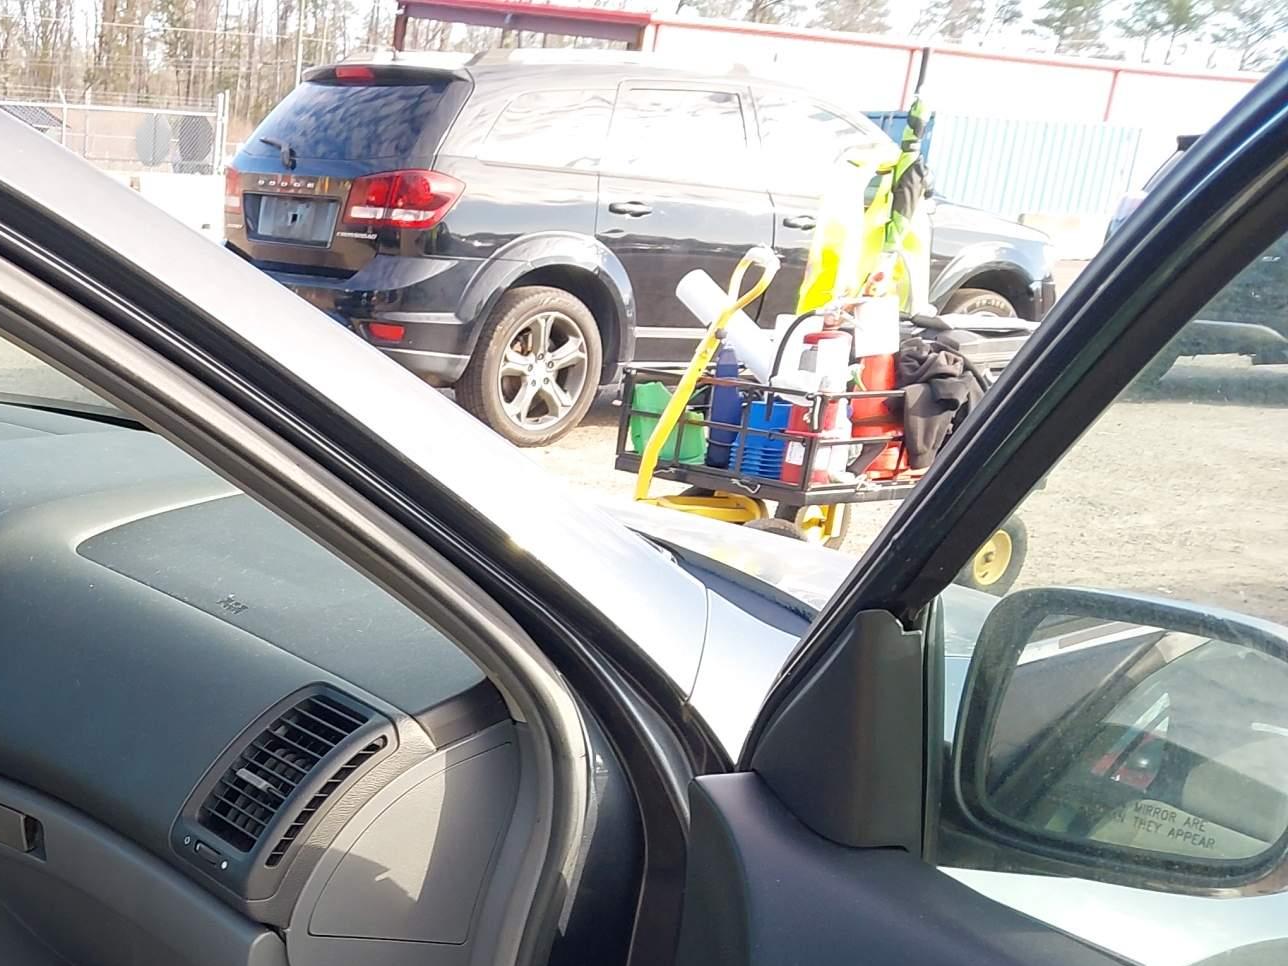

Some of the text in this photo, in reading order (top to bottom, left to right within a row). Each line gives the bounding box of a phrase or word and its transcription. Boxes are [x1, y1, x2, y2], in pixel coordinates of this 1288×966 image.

[1134, 801, 1176, 822] MIRROR
[1184, 816, 1208, 833] ARE
[1134, 815, 1216, 848] THEY APPEAR
